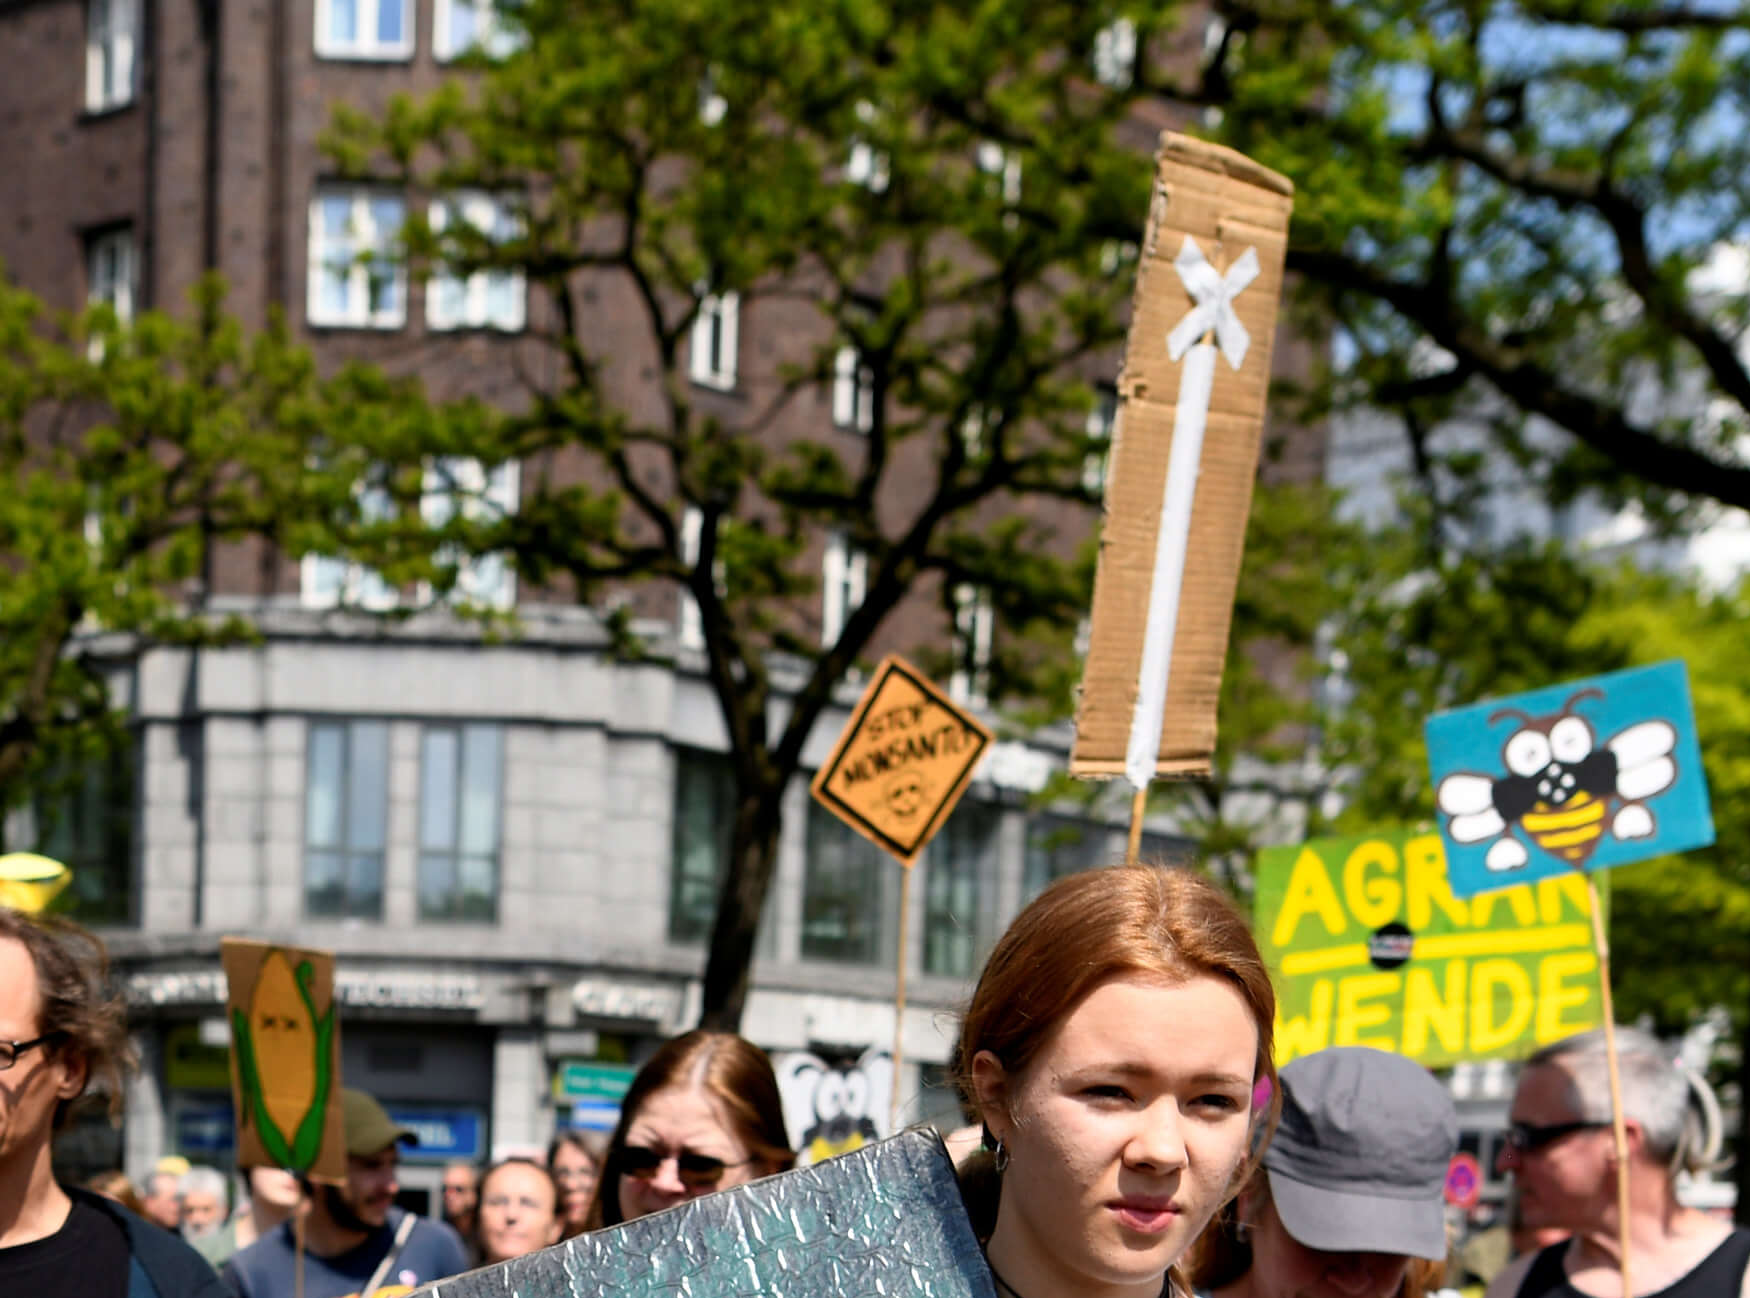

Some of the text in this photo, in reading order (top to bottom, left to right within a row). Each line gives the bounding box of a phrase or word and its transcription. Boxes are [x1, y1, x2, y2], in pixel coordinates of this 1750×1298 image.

[867, 704, 924, 742] STOP
[843, 724, 971, 788] MONSANTO
[1275, 951, 1599, 1066] WENDE
